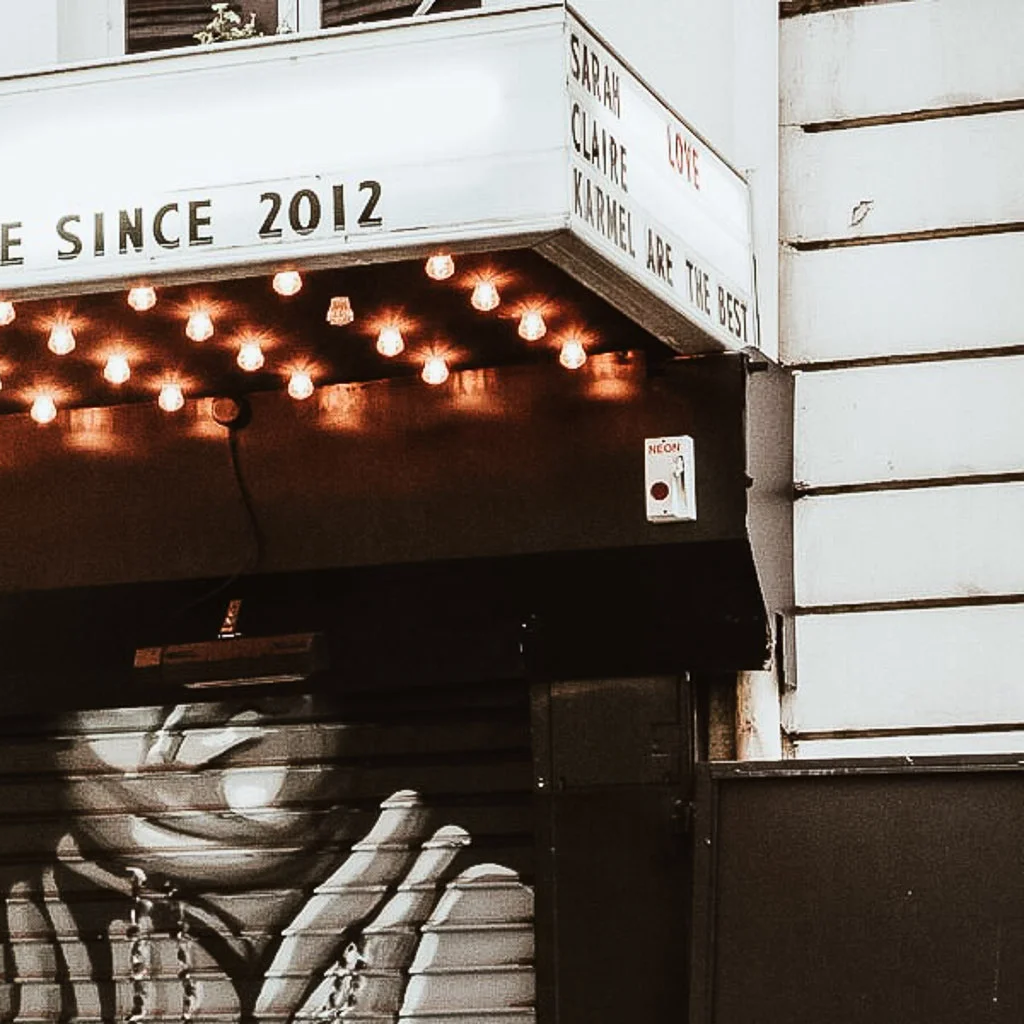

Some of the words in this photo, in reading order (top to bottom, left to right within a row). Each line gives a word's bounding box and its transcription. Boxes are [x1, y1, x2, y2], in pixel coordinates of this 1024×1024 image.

[570, 33, 621, 118] SARAH
[571, 103, 628, 193] CLAIRE
[57, 200, 214, 260] SINCE
[258, 180, 383, 239] 2012
[573, 168, 636, 258] KARMEL
[646, 228, 674, 287] ARE
[686, 259, 711, 315] THE
[718, 286, 748, 343] BEST
[648, 442, 680, 454] NEON
